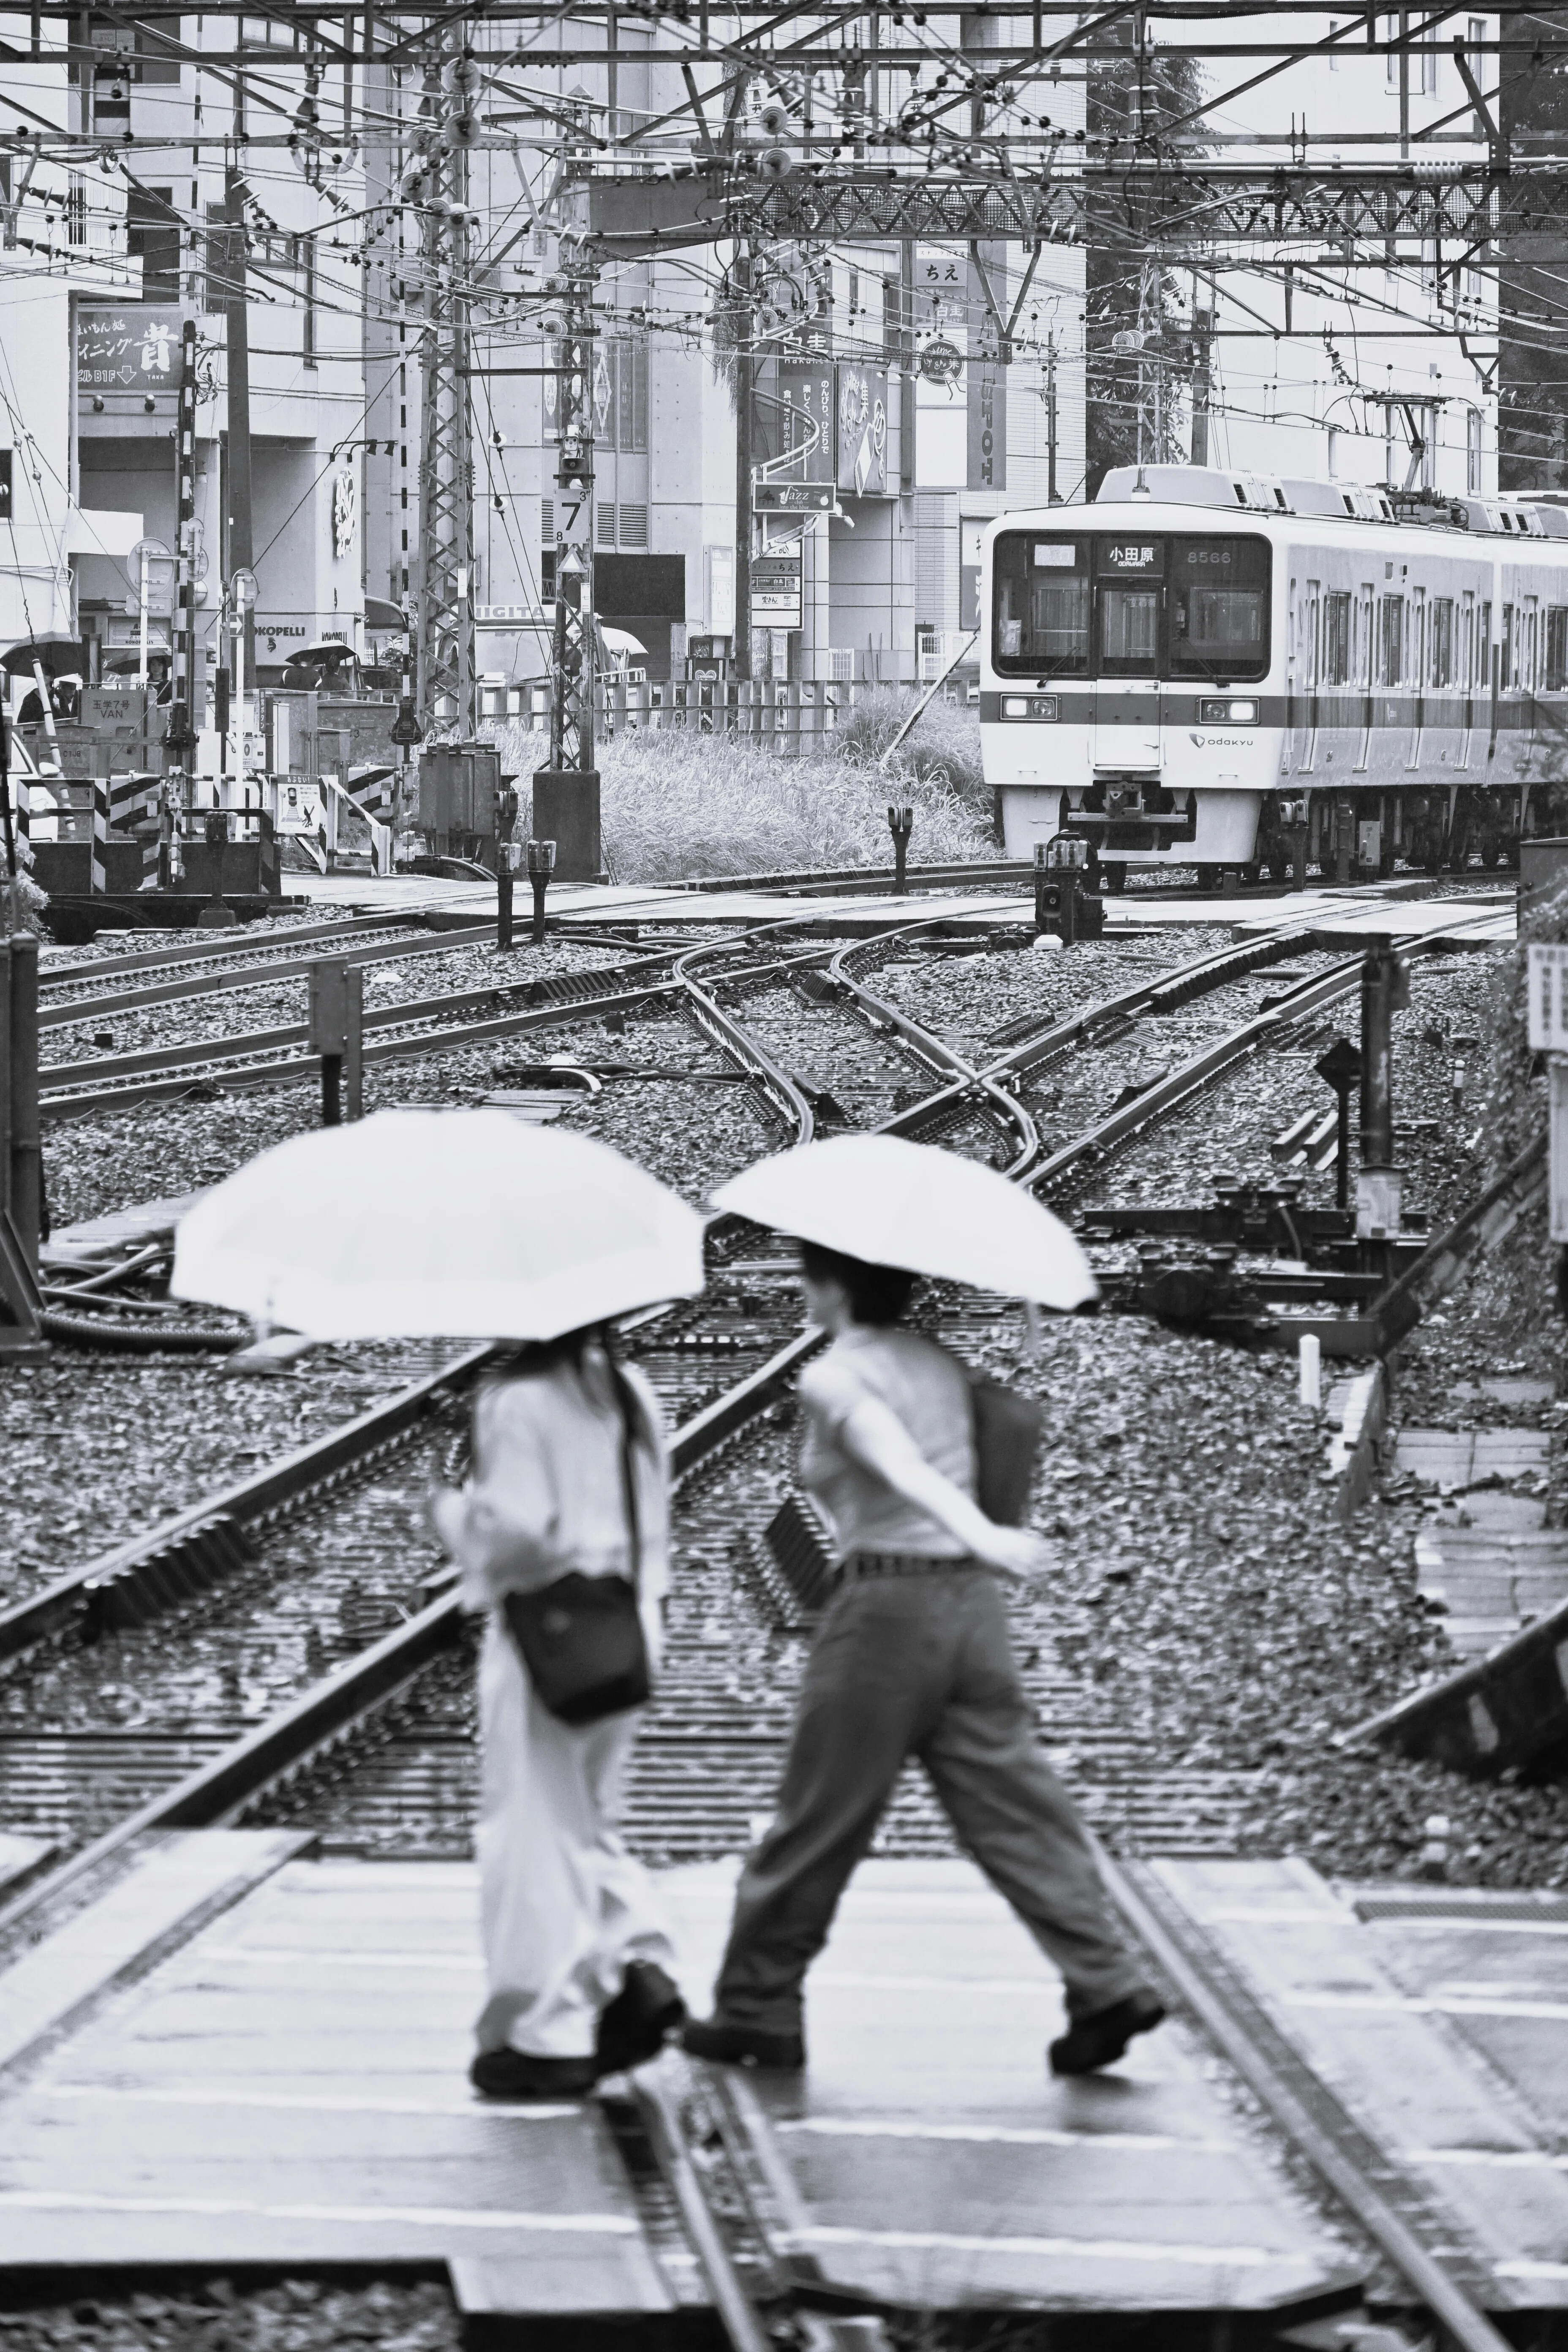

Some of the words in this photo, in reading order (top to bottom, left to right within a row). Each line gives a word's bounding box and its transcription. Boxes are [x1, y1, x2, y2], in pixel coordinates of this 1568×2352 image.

[926, 264, 958, 280] ちえ
[68, 338, 133, 360] イニング
[133, 322, 179, 372] 貴
[94, 370, 116, 382] B1F
[580, 491, 587, 502] 3
[561, 502, 581, 531] 7
[556, 531, 563, 542] 8
[1109, 546, 1154, 562] 小田原
[1188, 552, 1231, 564] 8566
[100, 710, 123, 718] VAN
